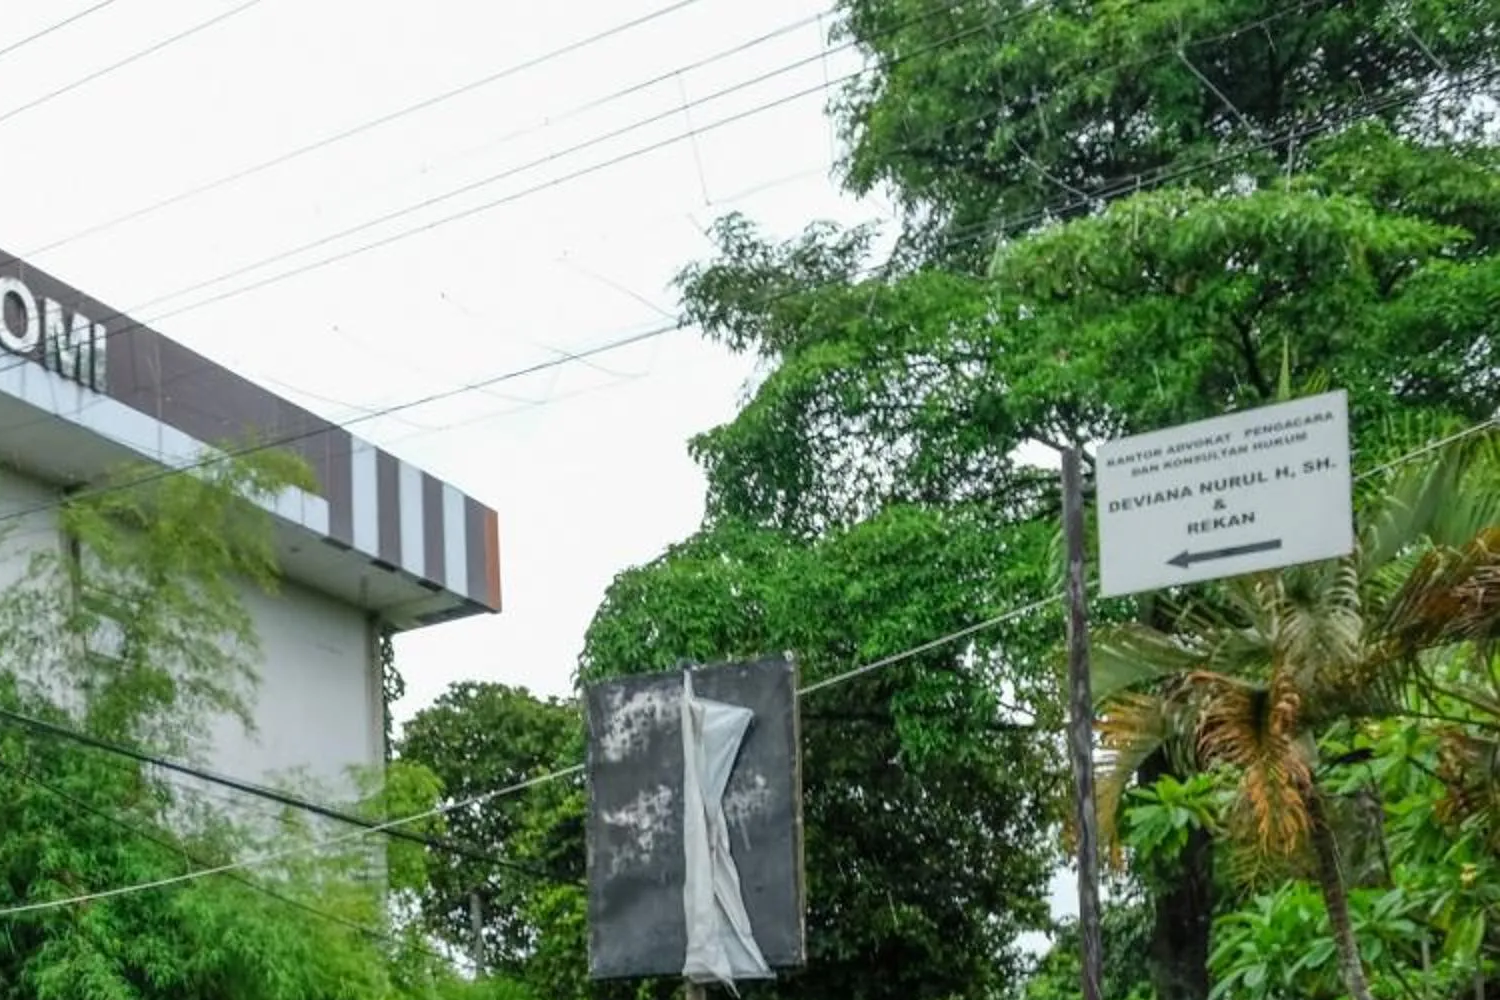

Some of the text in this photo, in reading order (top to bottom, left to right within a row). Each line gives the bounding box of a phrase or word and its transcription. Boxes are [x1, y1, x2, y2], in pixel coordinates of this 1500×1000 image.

[1107, 411, 1334, 467] KANTOR ADVOKAT PENGACARA
[1131, 432, 1307, 477] DAN KONSULTAN HUKUM
[1108, 487, 1193, 514] DEVIANA
[1199, 471, 1268, 495] NURUL
[1303, 457, 1337, 475] SH.
[1213, 498, 1227, 511] &
[1187, 512, 1256, 535] REKAN
